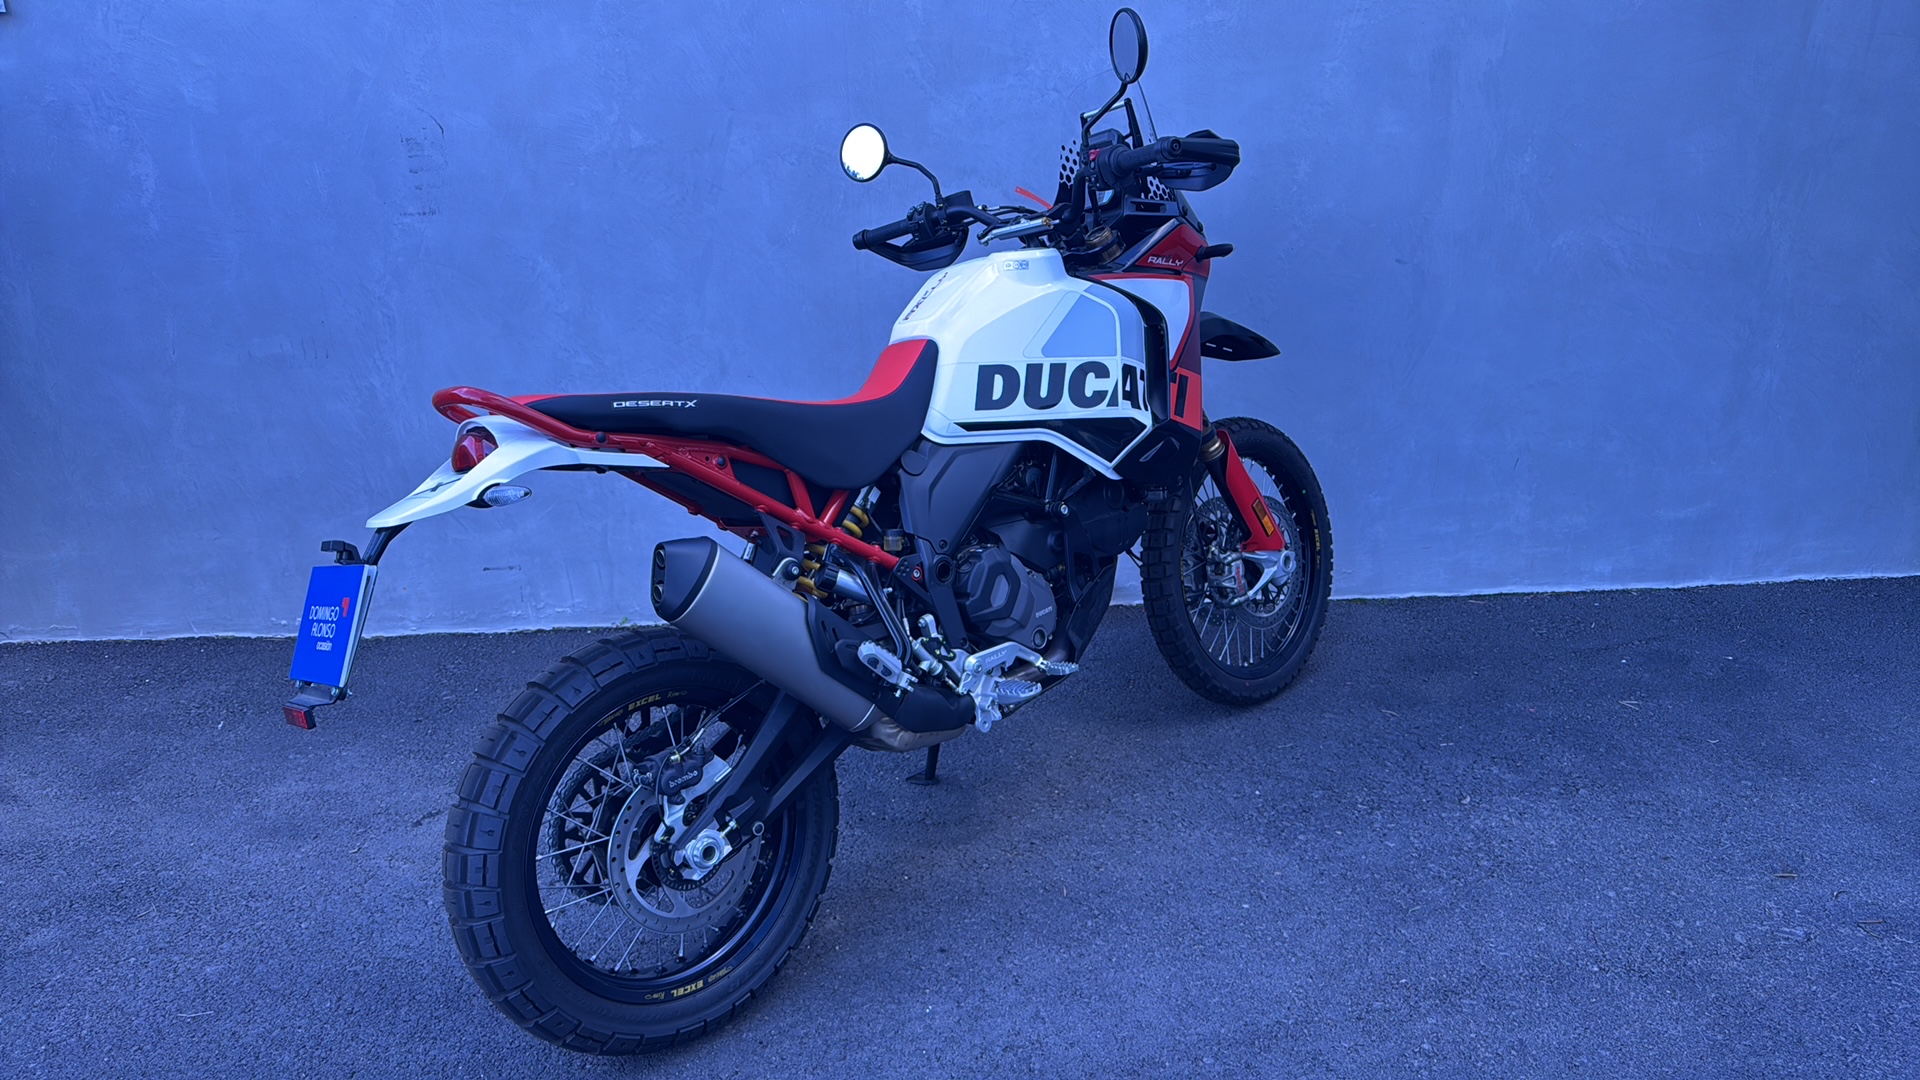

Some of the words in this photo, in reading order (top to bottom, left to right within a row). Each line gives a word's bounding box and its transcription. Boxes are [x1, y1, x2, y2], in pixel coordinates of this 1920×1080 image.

[1147, 256, 1184, 266] RALLY
[613, 399, 698, 408] DESERTX
[309, 605, 340, 621] DOMINGO
[1035, 605, 1053, 618] DUCATI
[310, 622, 336, 638] ALONSO
[628, 694, 662, 711] EXCEL
[668, 770, 698, 788] brembo
[670, 979, 704, 998] EXCEL
